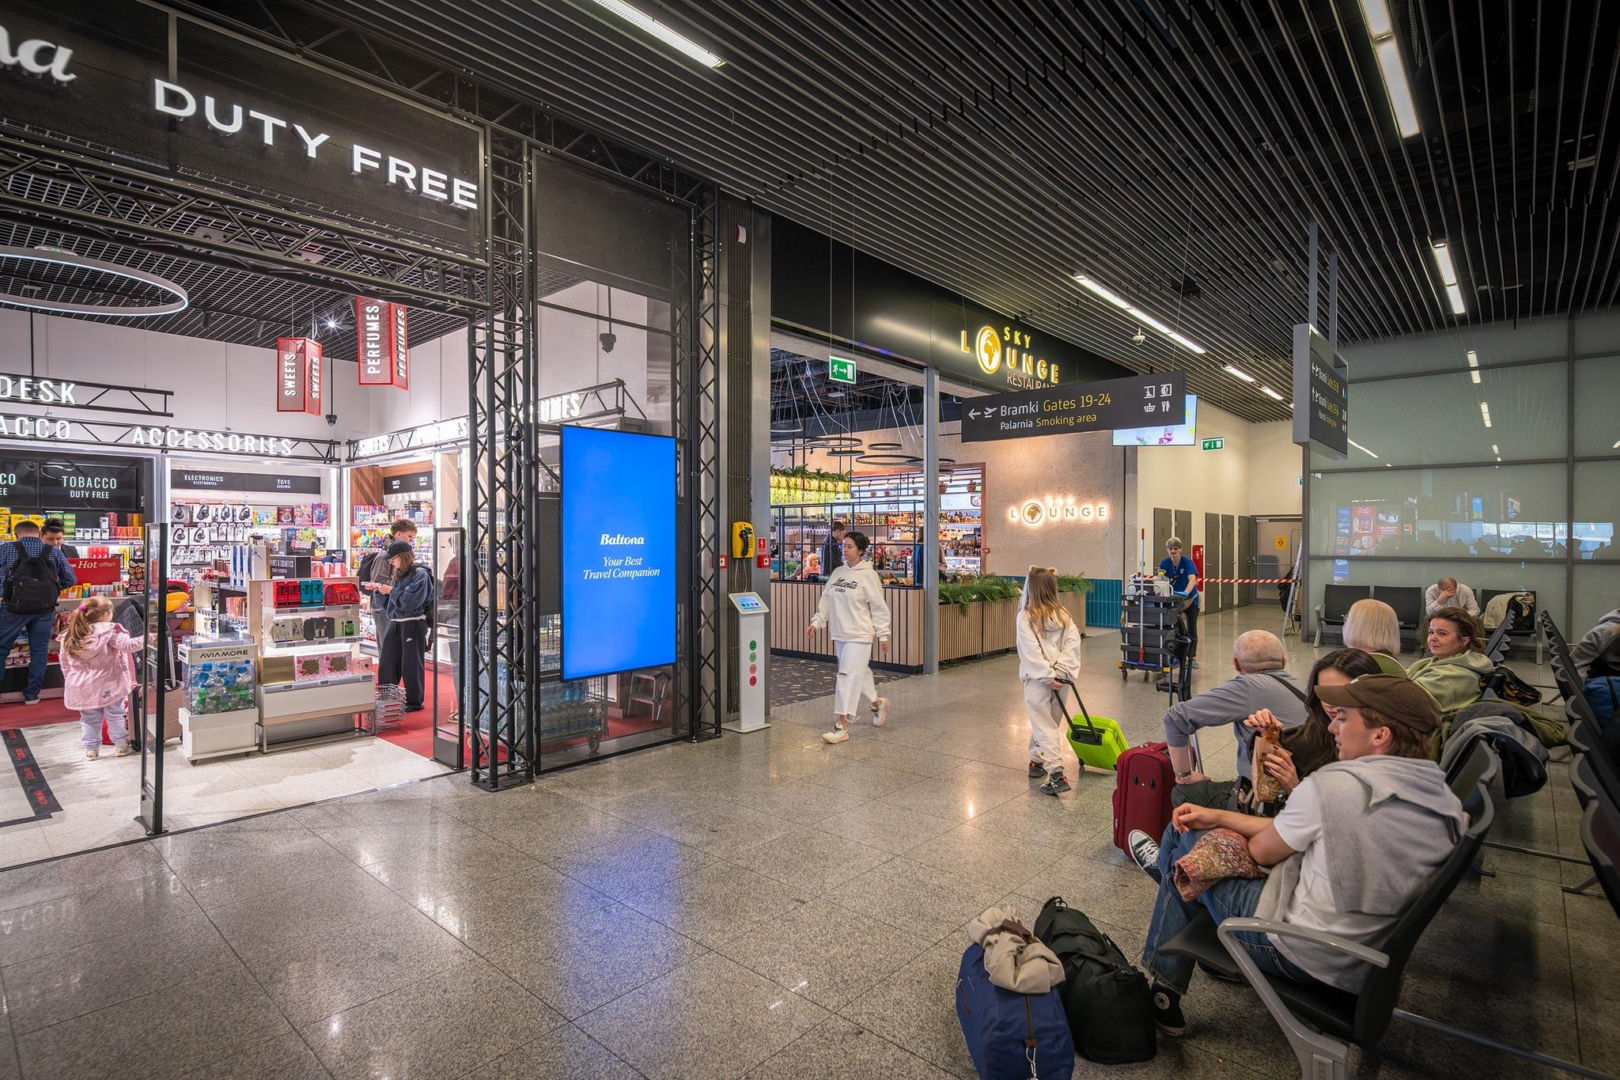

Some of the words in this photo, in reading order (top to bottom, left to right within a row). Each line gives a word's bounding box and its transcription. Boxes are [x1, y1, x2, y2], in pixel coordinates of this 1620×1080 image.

[154, 79, 330, 159] DUTY
[351, 144, 478, 210] FREE
[366, 305, 380, 374] PERFUMES
[397, 309, 406, 378] PERFUMES
[1004, 326, 1031, 349] SKY
[284, 353, 296, 396] SWEETS
[312, 357, 320, 399] SWEETS
[0, 376, 76, 405] DESK
[1000, 401, 1039, 417] Bramki
[1043, 399, 1076, 412] Gates
[1079, 393, 1111, 408] 19-24
[1000, 419, 1034, 431] Palarnia
[1035, 416, 1075, 428] Smoking
[1076, 413, 1097, 423] area
[132, 426, 292, 456] ACCESSORIES
[61, 475, 117, 489] TOBACCO
[184, 474, 224, 482] ELECTRONICS
[70, 490, 90, 498] DUTY
[92, 490, 110, 499] FREE
[600, 533, 645, 545] Baltona
[78, 560, 98, 569] Hot
[603, 556, 624, 567] Your
[624, 555, 644, 567] Best
[583, 568, 612, 580] Travel
[612, 566, 661, 580] Companion
[200, 649, 249, 659] AVIAMORE
